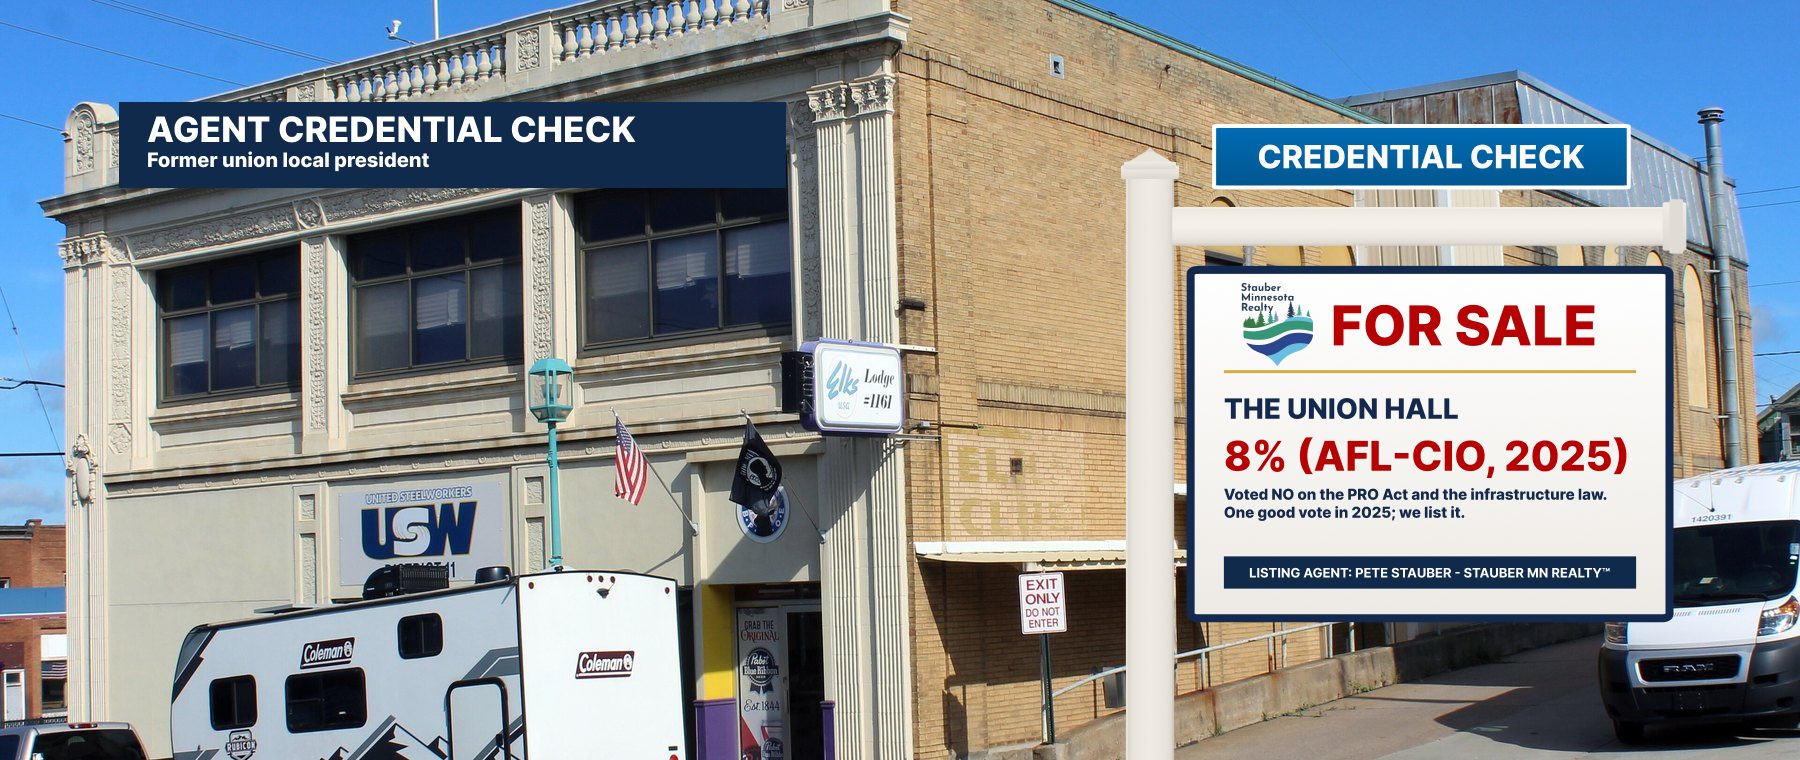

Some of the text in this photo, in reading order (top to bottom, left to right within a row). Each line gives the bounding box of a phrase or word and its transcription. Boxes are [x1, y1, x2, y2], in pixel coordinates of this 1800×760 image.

[826, 360, 859, 400] Elks
[864, 368, 894, 388] Lodge
[366, 486, 473, 505] UNITED STEELWORKERS
[1692, 514, 1732, 523] 1420391
[361, 501, 478, 561] USW
[1026, 578, 1058, 591] EXIT
[1025, 592, 1060, 605] ONLY
[1026, 606, 1060, 618] DO NOT
[744, 620, 774, 630] GRAB THE
[1028, 618, 1059, 629] ENTER
[740, 629, 780, 643] ORIGINAL
[304, 643, 344, 662] Coleman
[750, 652, 770, 665] Pabst
[579, 653, 622, 672] Coleman
[1663, 663, 1714, 673] RAM
[744, 666, 778, 675] Blue Ribbon
[226, 740, 256, 752] RUBICON
